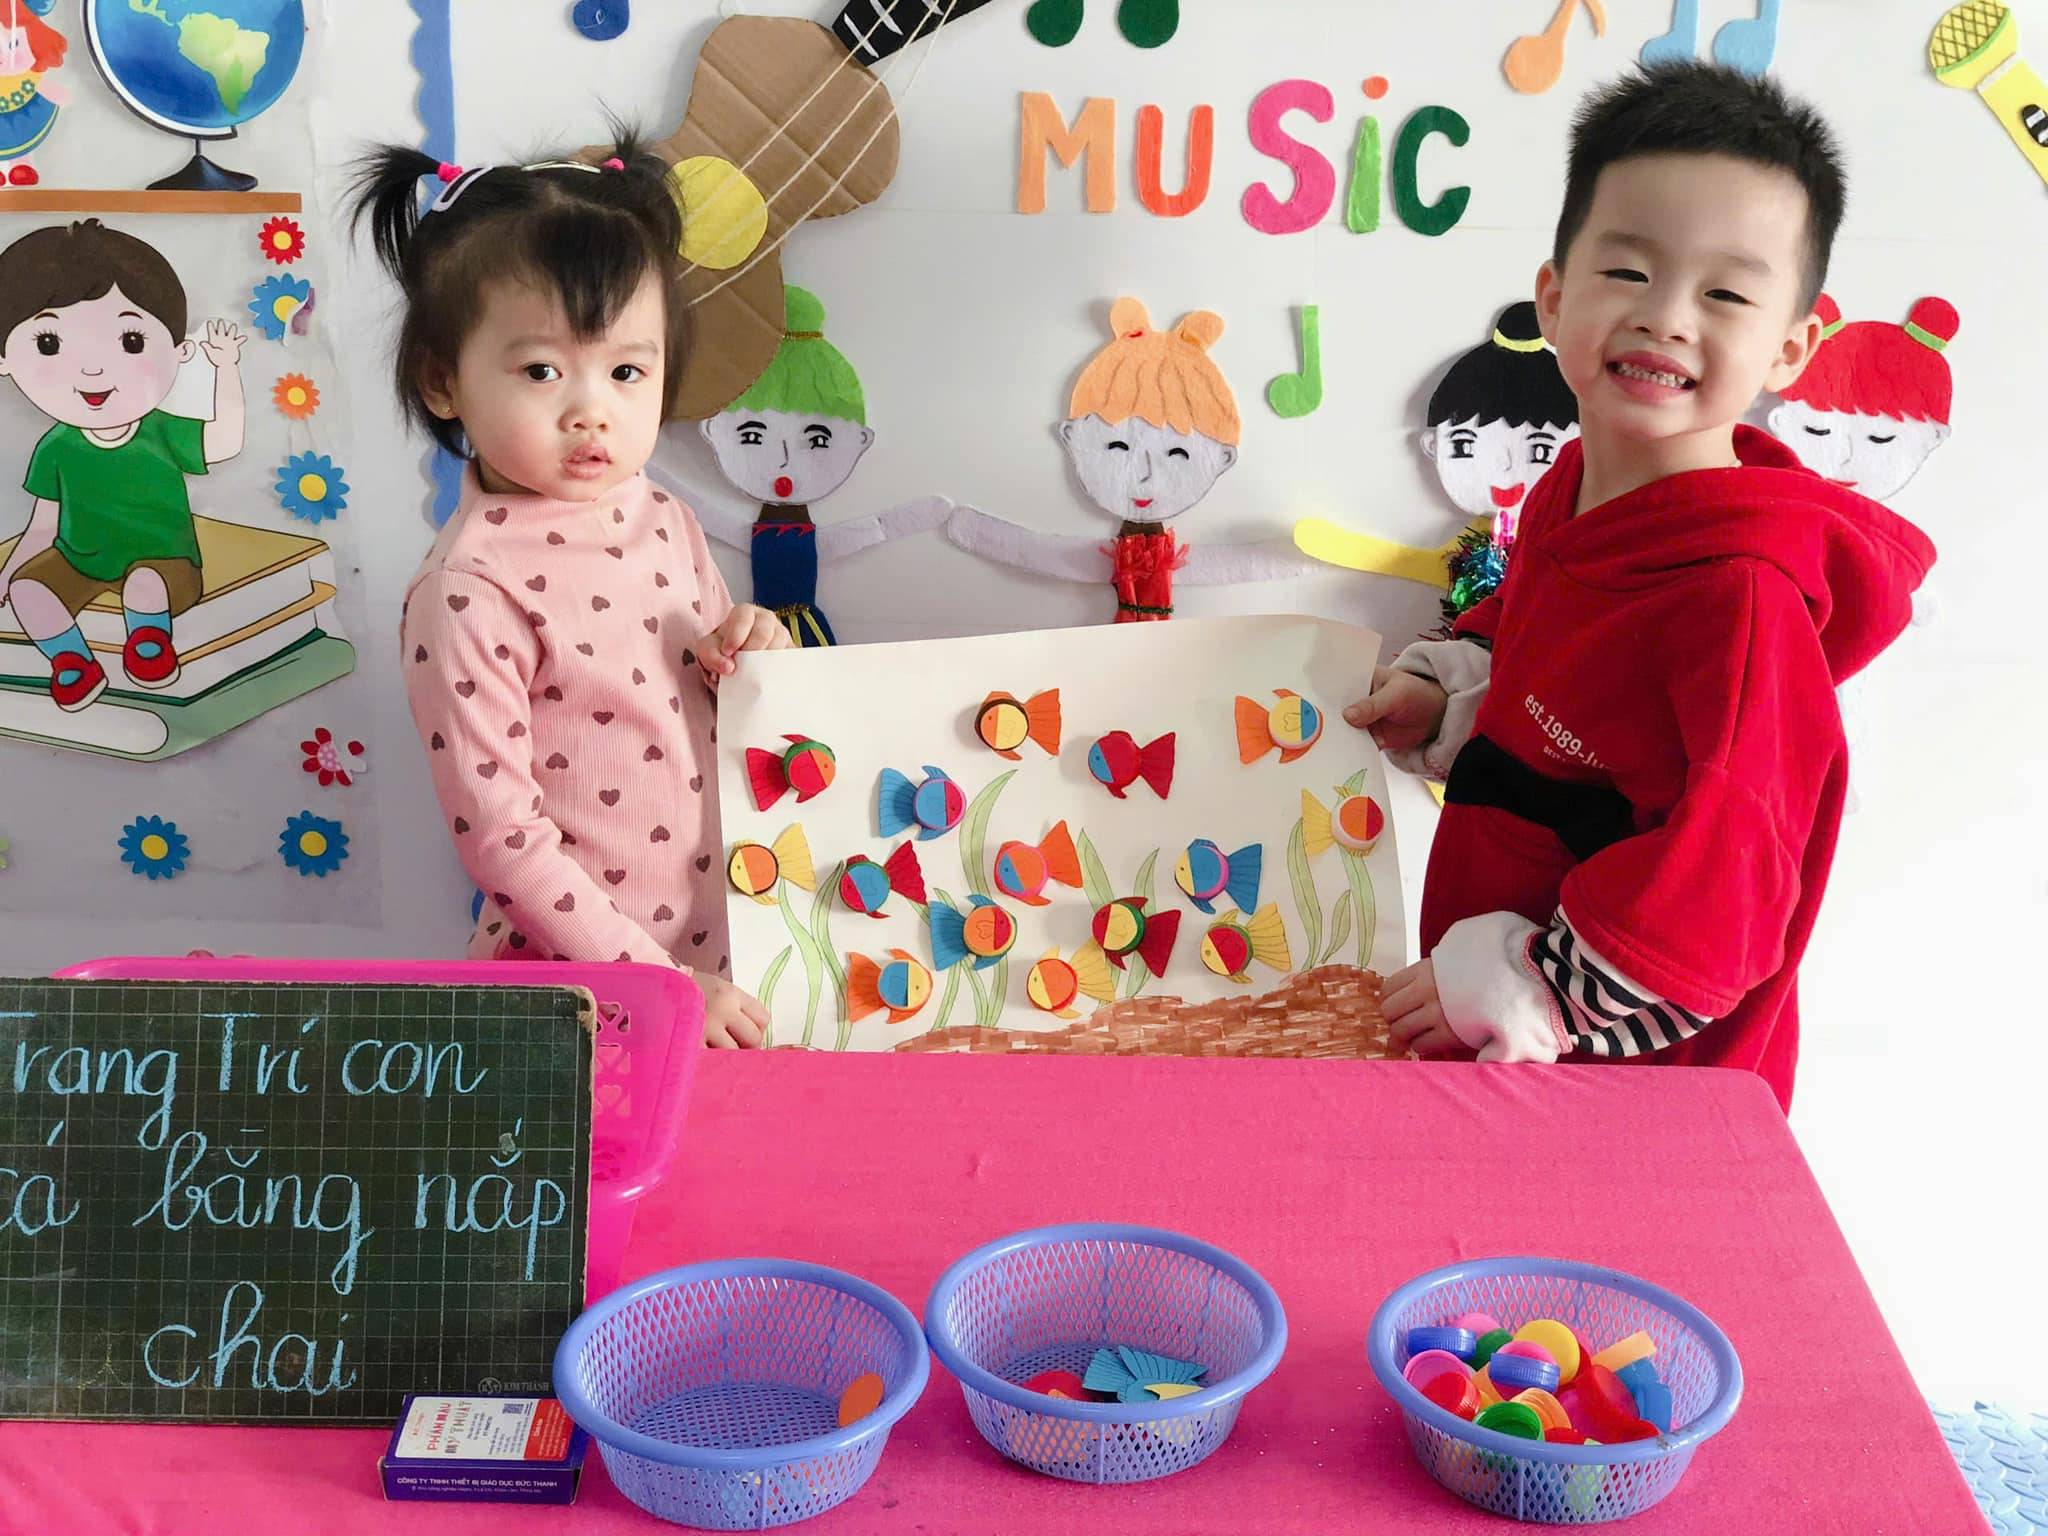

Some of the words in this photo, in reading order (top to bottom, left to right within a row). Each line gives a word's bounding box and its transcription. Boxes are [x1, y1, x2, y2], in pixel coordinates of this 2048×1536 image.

[0, 1011, 179, 1150] rang
[200, 1012, 320, 1095] Trí
[342, 1039, 488, 1098] con
[415, 1117, 566, 1281] nắp
[144, 1280, 357, 1396] chai
